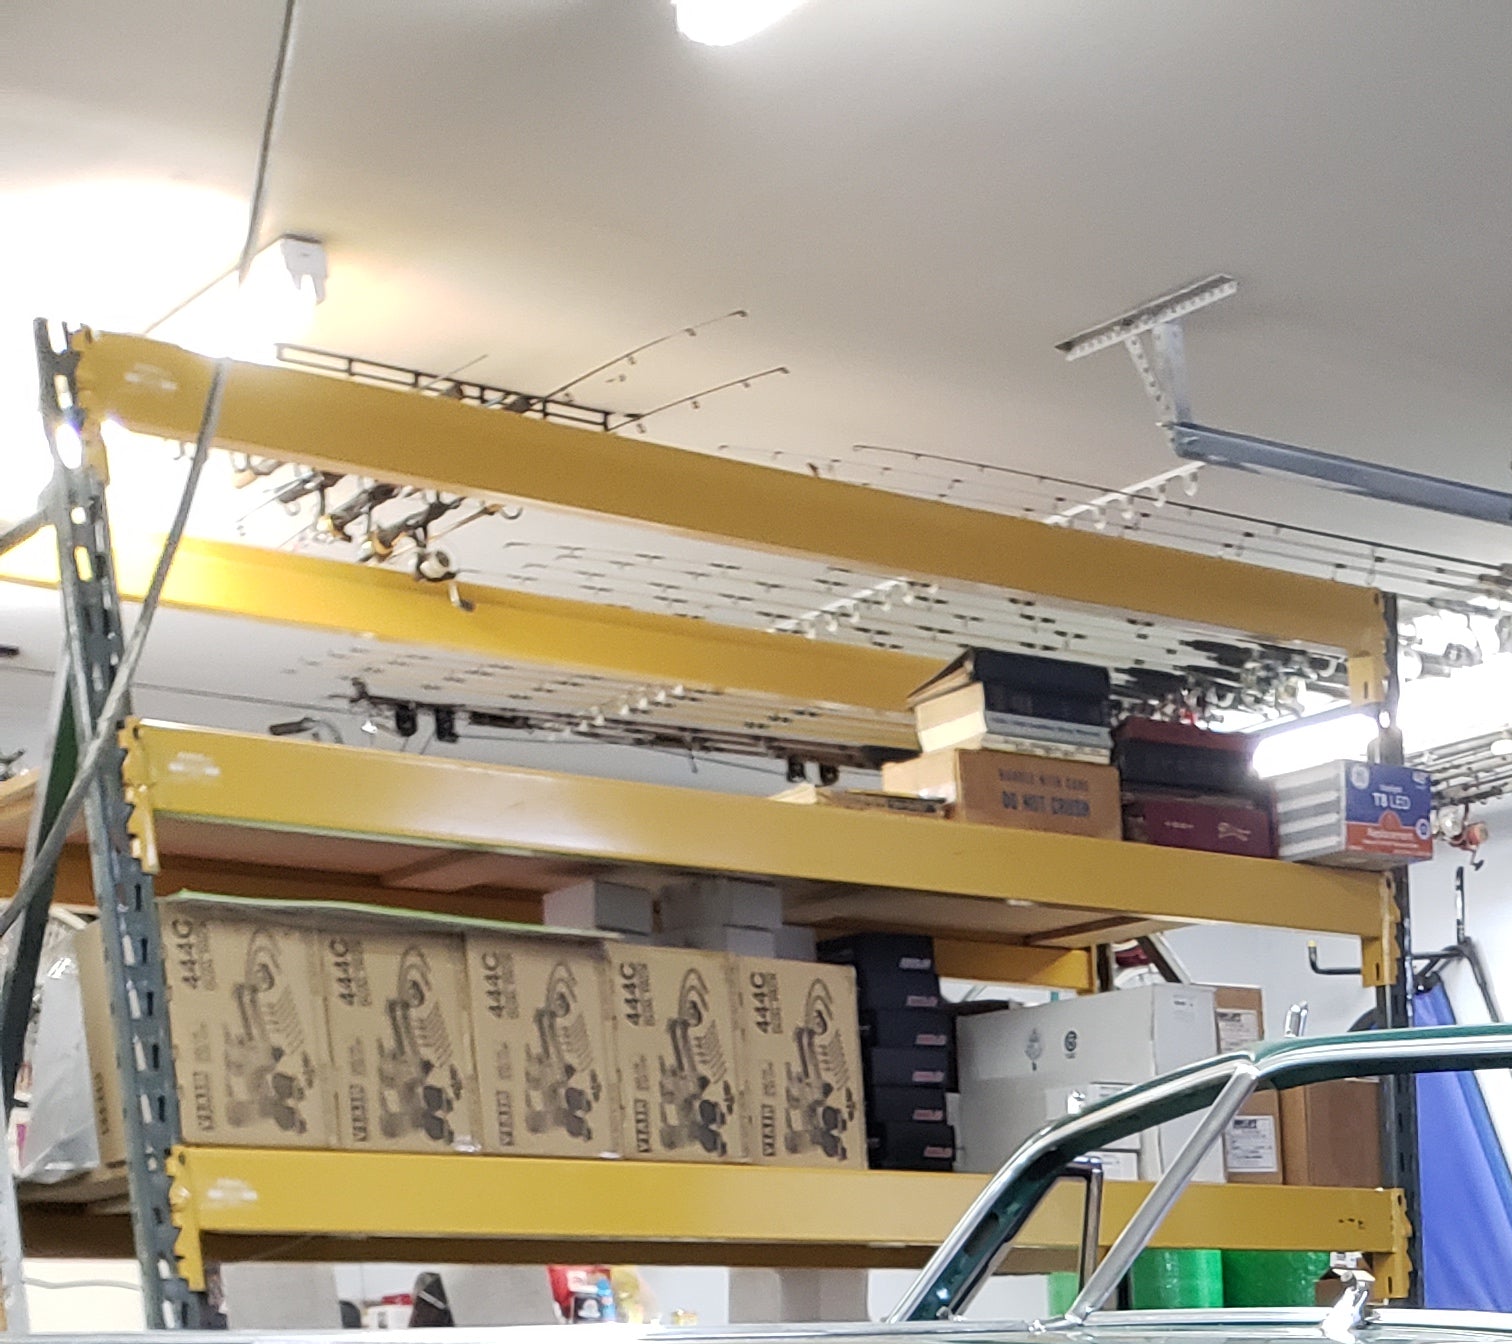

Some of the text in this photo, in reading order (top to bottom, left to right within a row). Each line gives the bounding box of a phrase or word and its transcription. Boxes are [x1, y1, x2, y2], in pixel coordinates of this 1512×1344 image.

[1389, 794, 1412, 811] LED
[171, 918, 199, 991] 444C
[329, 937, 355, 1007] 444C
[482, 951, 506, 1020] 444C
[620, 961, 641, 1027] 444C
[749, 970, 770, 1035] 444C
